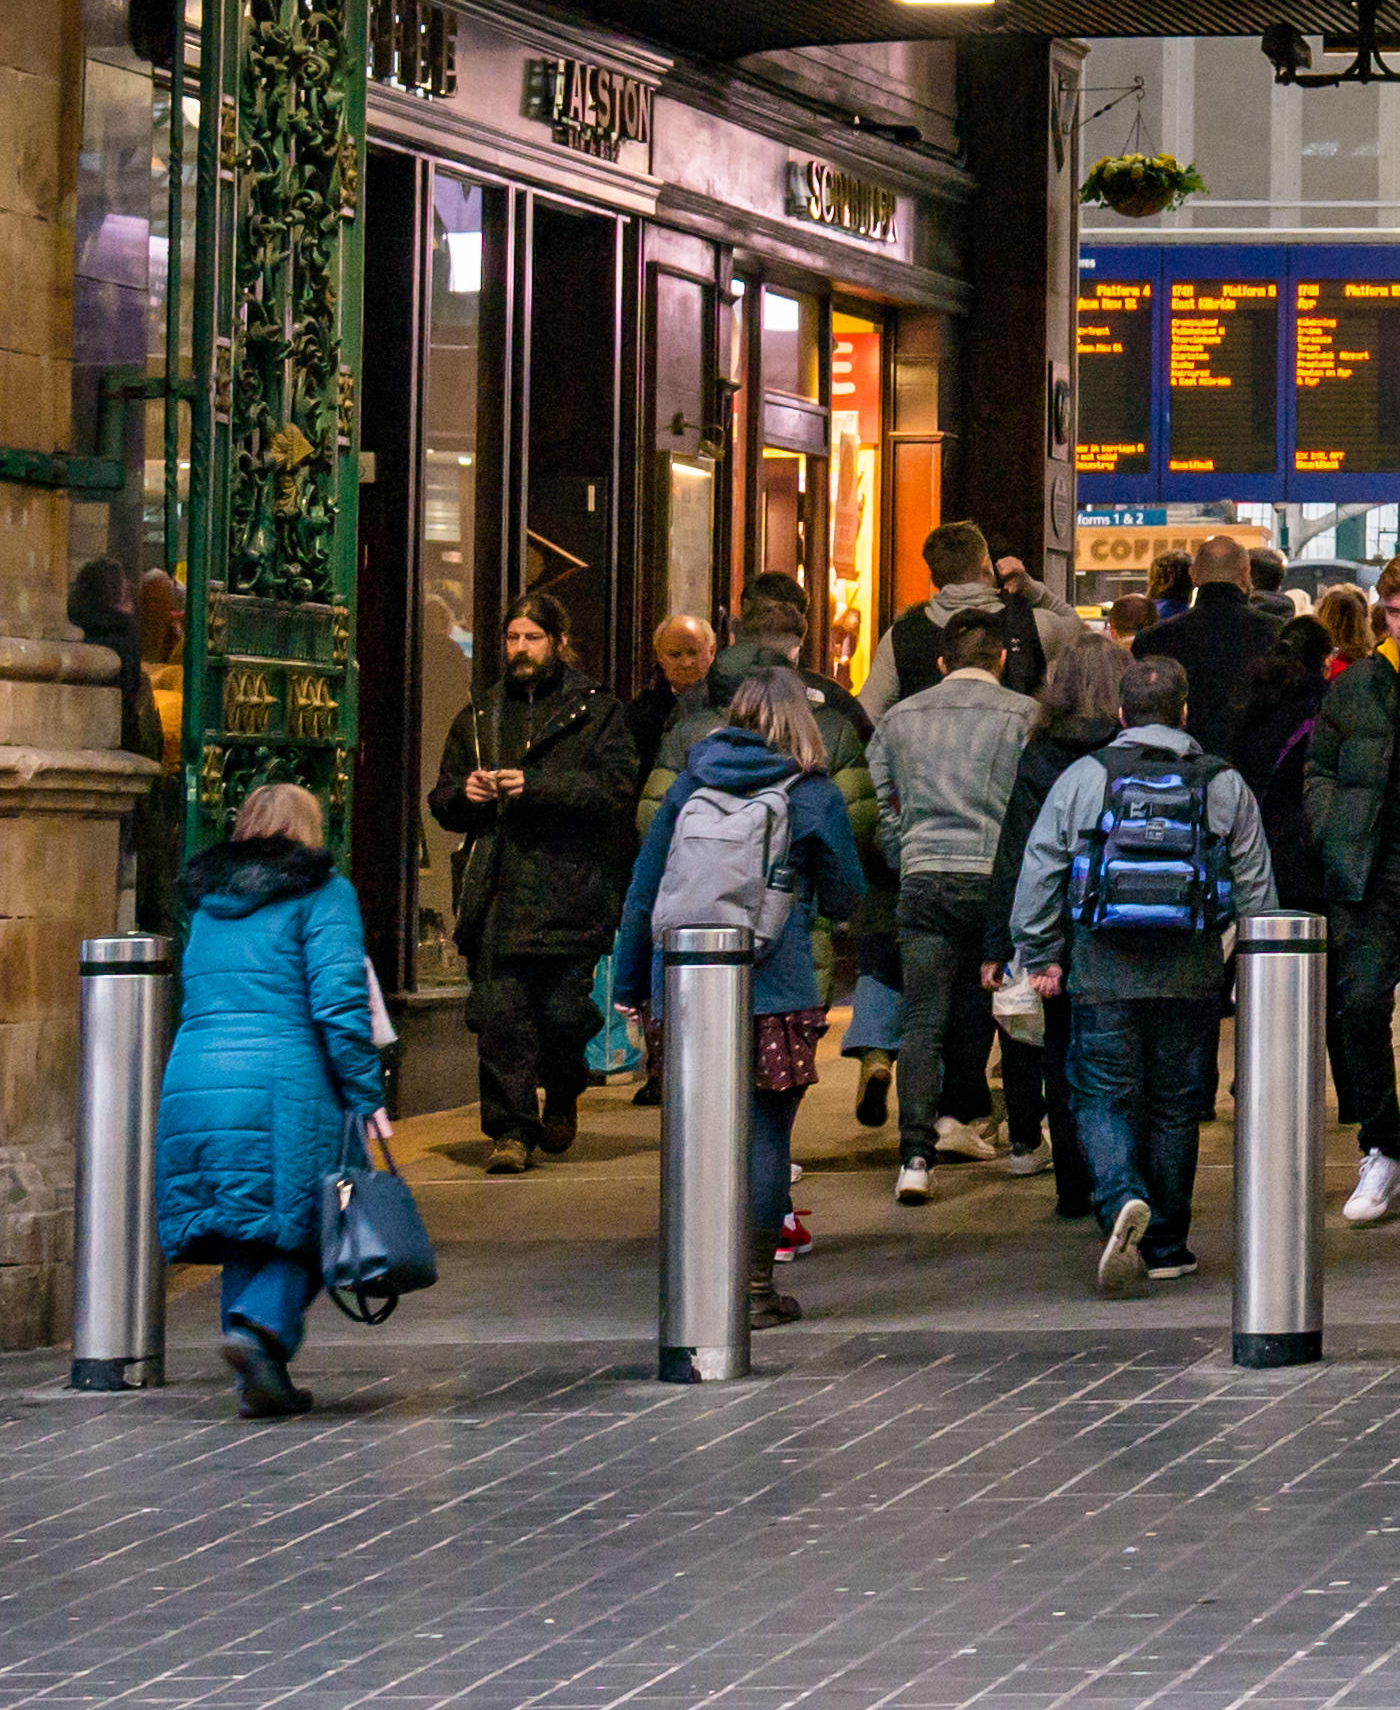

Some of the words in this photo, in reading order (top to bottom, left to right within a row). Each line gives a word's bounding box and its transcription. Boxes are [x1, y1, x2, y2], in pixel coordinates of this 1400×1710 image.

[1113, 513, 1120, 525] 1
[1123, 513, 1133, 525] &
[1136, 513, 1144, 525] 2
